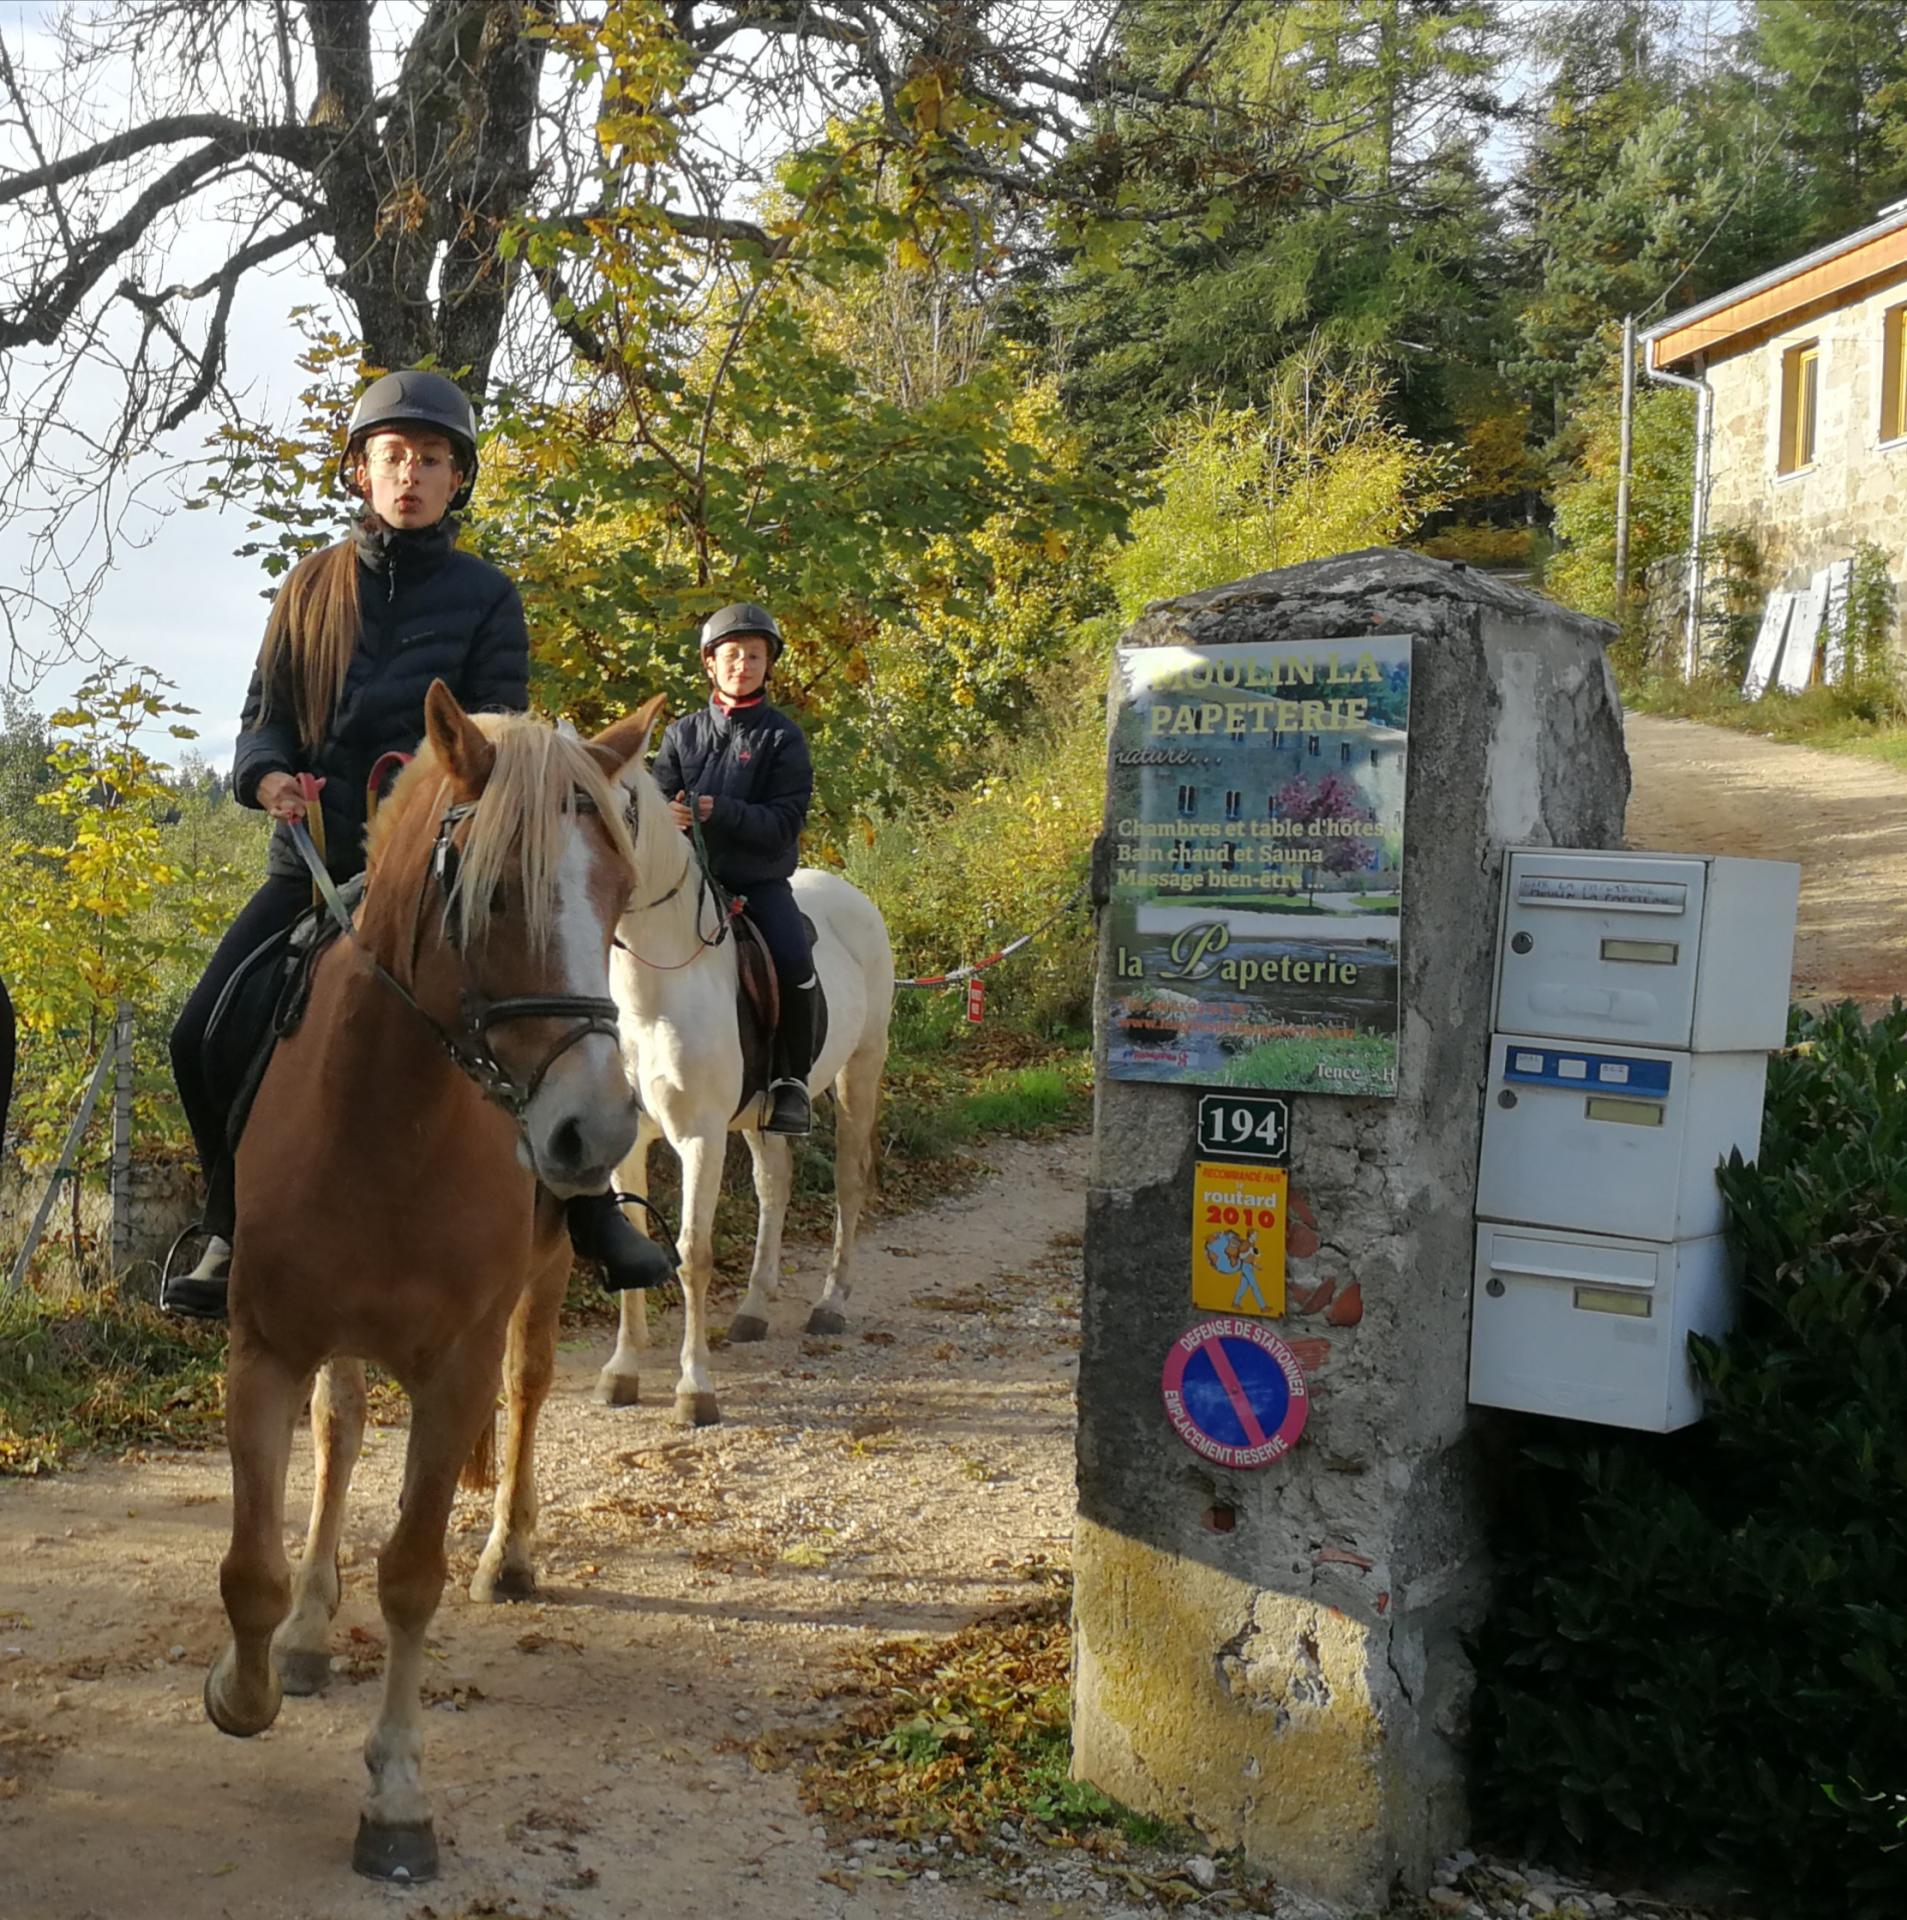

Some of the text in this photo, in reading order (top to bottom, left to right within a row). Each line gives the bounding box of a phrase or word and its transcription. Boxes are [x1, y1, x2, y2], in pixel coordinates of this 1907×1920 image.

[1327, 651, 1382, 684] LA
[1150, 698, 1369, 736] PAPETERIE
[1118, 818, 1385, 837] Chambres et table d'hôtes
[1118, 845, 1322, 862] Bain chaud et Sauna
[1117, 869, 1204, 891] Massage
[1208, 871, 1303, 889] bien-être
[1118, 920, 1358, 990] la Papeterie
[1316, 1063, 1361, 1079] Tence
[1209, 1107, 1278, 1146] 194
[1203, 1190, 1277, 1208] routard
[1205, 1206, 1275, 1228] 2010
[1179, 1320, 1304, 1396] DEFENSE DE STATIONNER
[1164, 1390, 1288, 1464] EMPLACEMENT RESERVE
